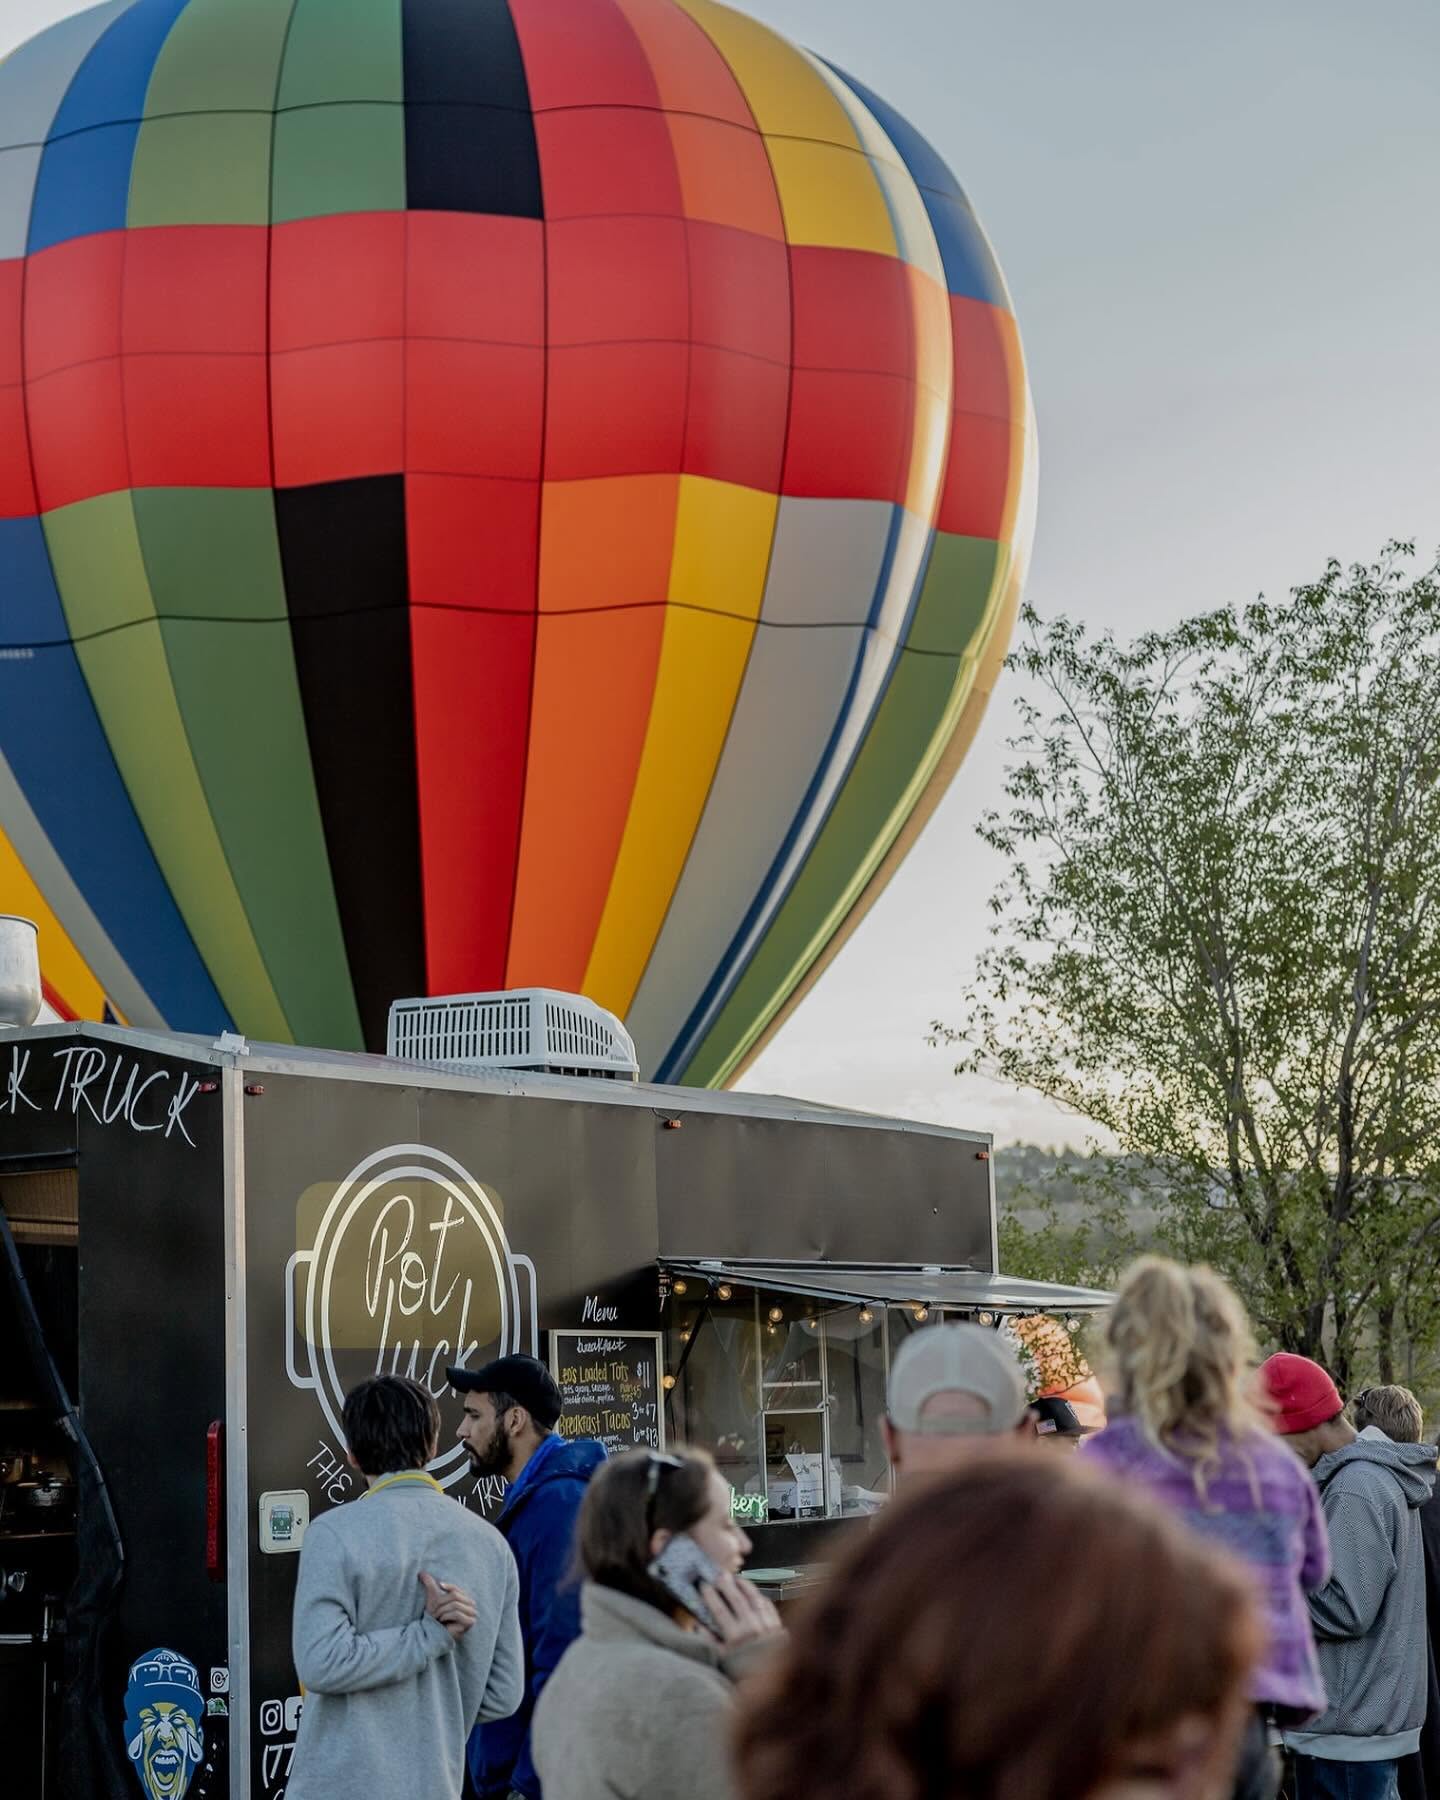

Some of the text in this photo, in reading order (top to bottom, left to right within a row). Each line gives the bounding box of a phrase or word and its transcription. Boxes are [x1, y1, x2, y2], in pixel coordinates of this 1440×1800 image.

[0, 1046, 200, 1148] K TRUCK
[365, 1195, 465, 1318] Pot
[582, 1295, 618, 1323] Menu
[576, 1337, 627, 1356] breakfast
[580, 1361, 608, 1384] Loaded
[610, 1362, 629, 1382] Tots
[636, 1361, 650, 1388] $11
[602, 1409, 631, 1433] Tacos
[631, 1402, 639, 1420] 3
[646, 1403, 656, 1422] $7
[306, 1440, 353, 1505] THE
[471, 1474, 509, 1516] TRU
[262, 1742, 297, 1789] (77
